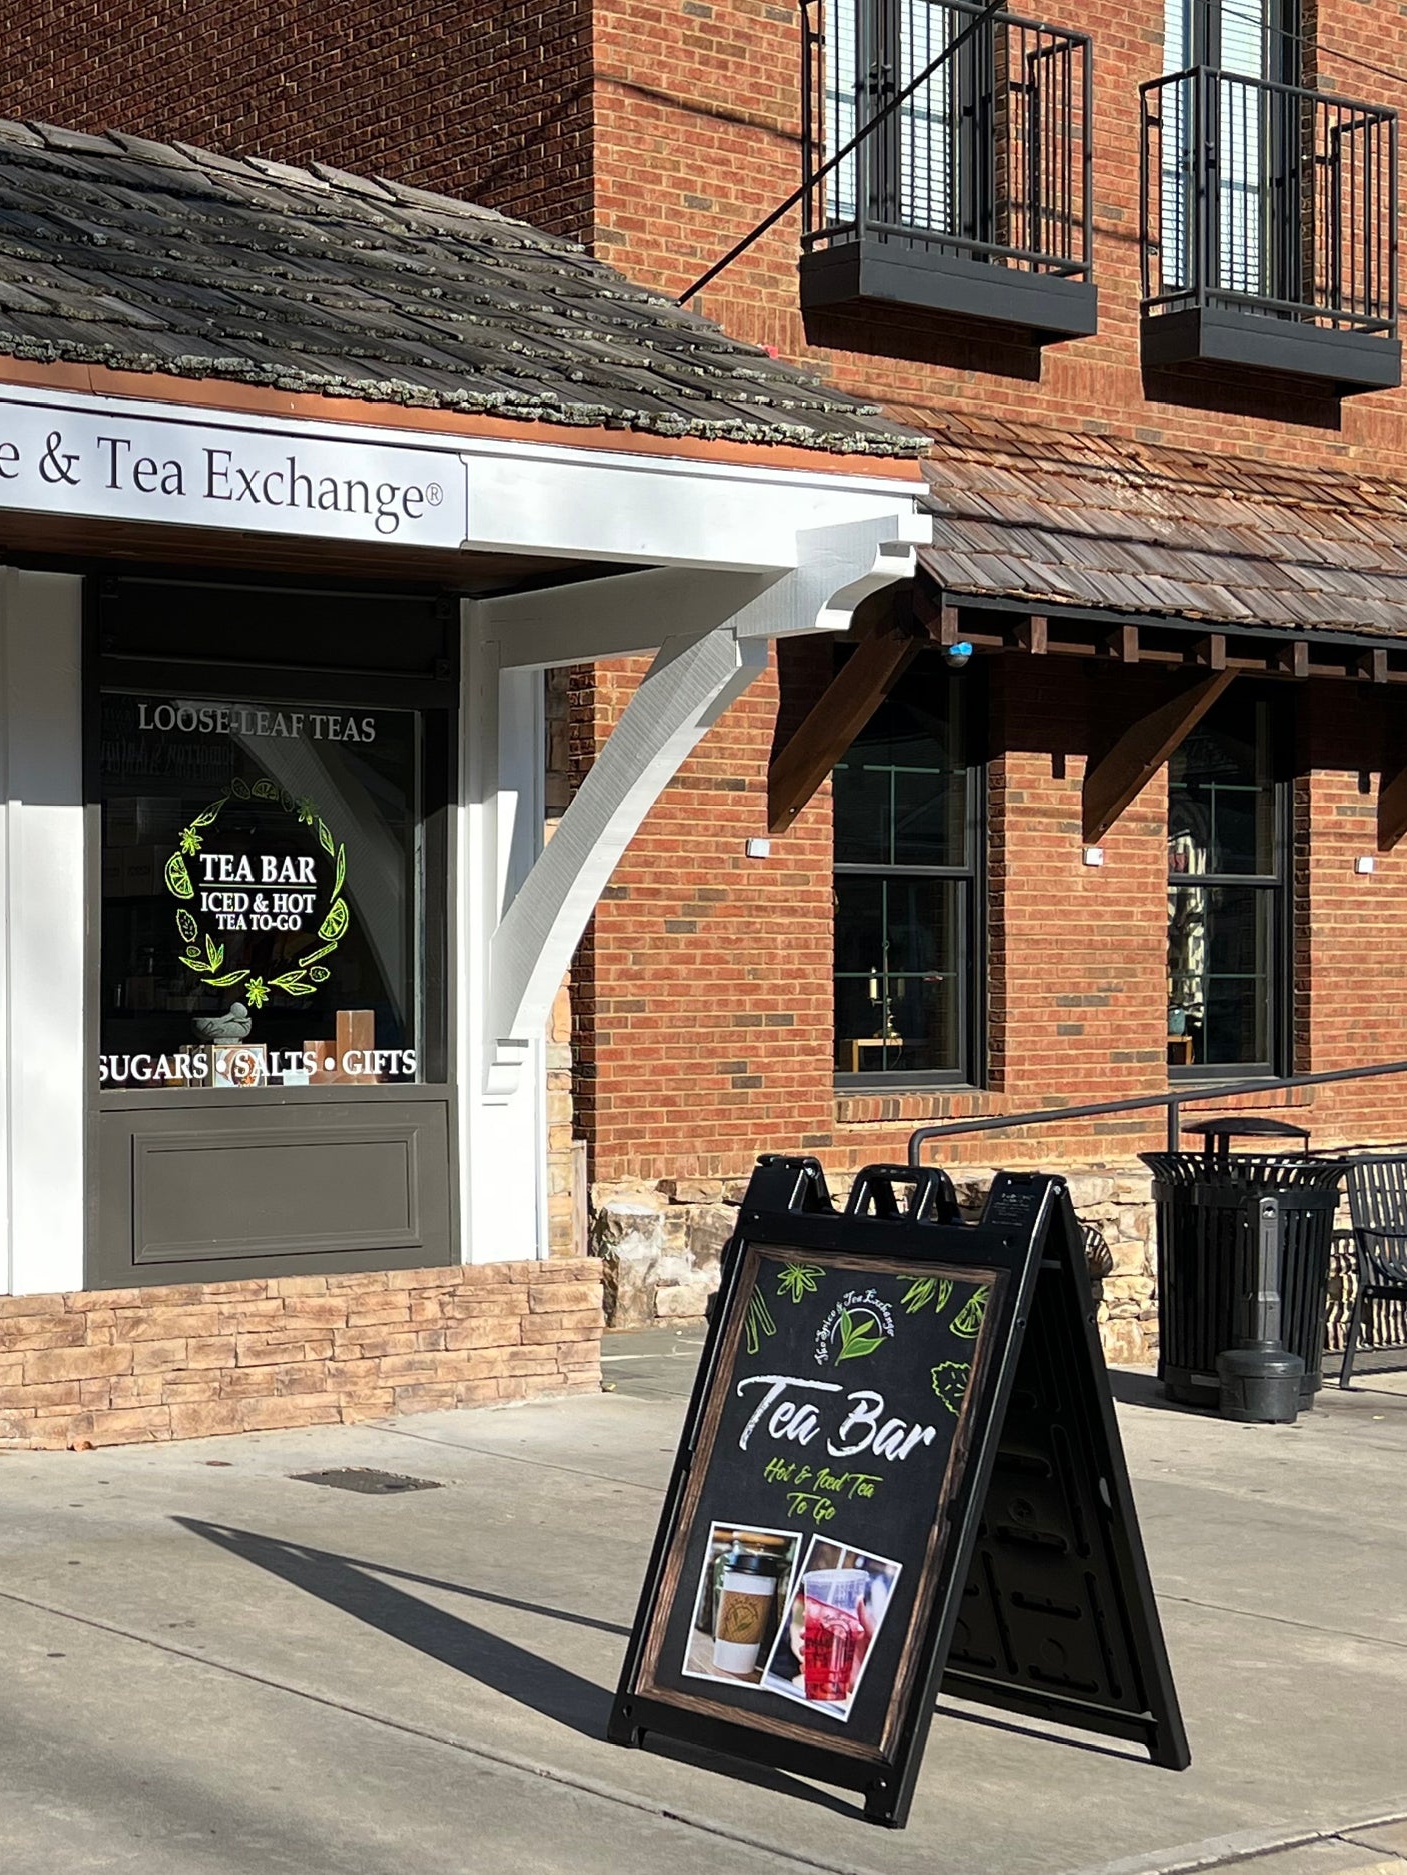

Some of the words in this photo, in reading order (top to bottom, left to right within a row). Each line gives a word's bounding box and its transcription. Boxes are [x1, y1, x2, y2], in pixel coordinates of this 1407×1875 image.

[38, 430, 81, 485] &
[96, 435, 186, 497] Tea
[137, 703, 305, 739] LOOSE-LEAF
[310, 714, 376, 743] TEAS
[199, 853, 255, 882] TEA
[260, 855, 317, 884] BAR
[200, 891, 249, 912] ICED
[253, 892, 269, 913] &
[272, 893, 316, 914] HOT
[215, 913, 248, 931] TEA
[249, 914, 302, 931] TO-GO
[99, 1053, 208, 1082] SUGARS
[234, 1051, 318, 1077] SALTS
[342, 1049, 417, 1075] GIFTS
[737, 1374, 844, 1451] Tea
[826, 1390, 937, 1462] Bar
[763, 1456, 796, 1484] Hot
[794, 1465, 813, 1485] &
[812, 1467, 850, 1492] Iced
[846, 1472, 884, 1501] Tea
[786, 1491, 822, 1518] To
[813, 1498, 837, 1525] Go
